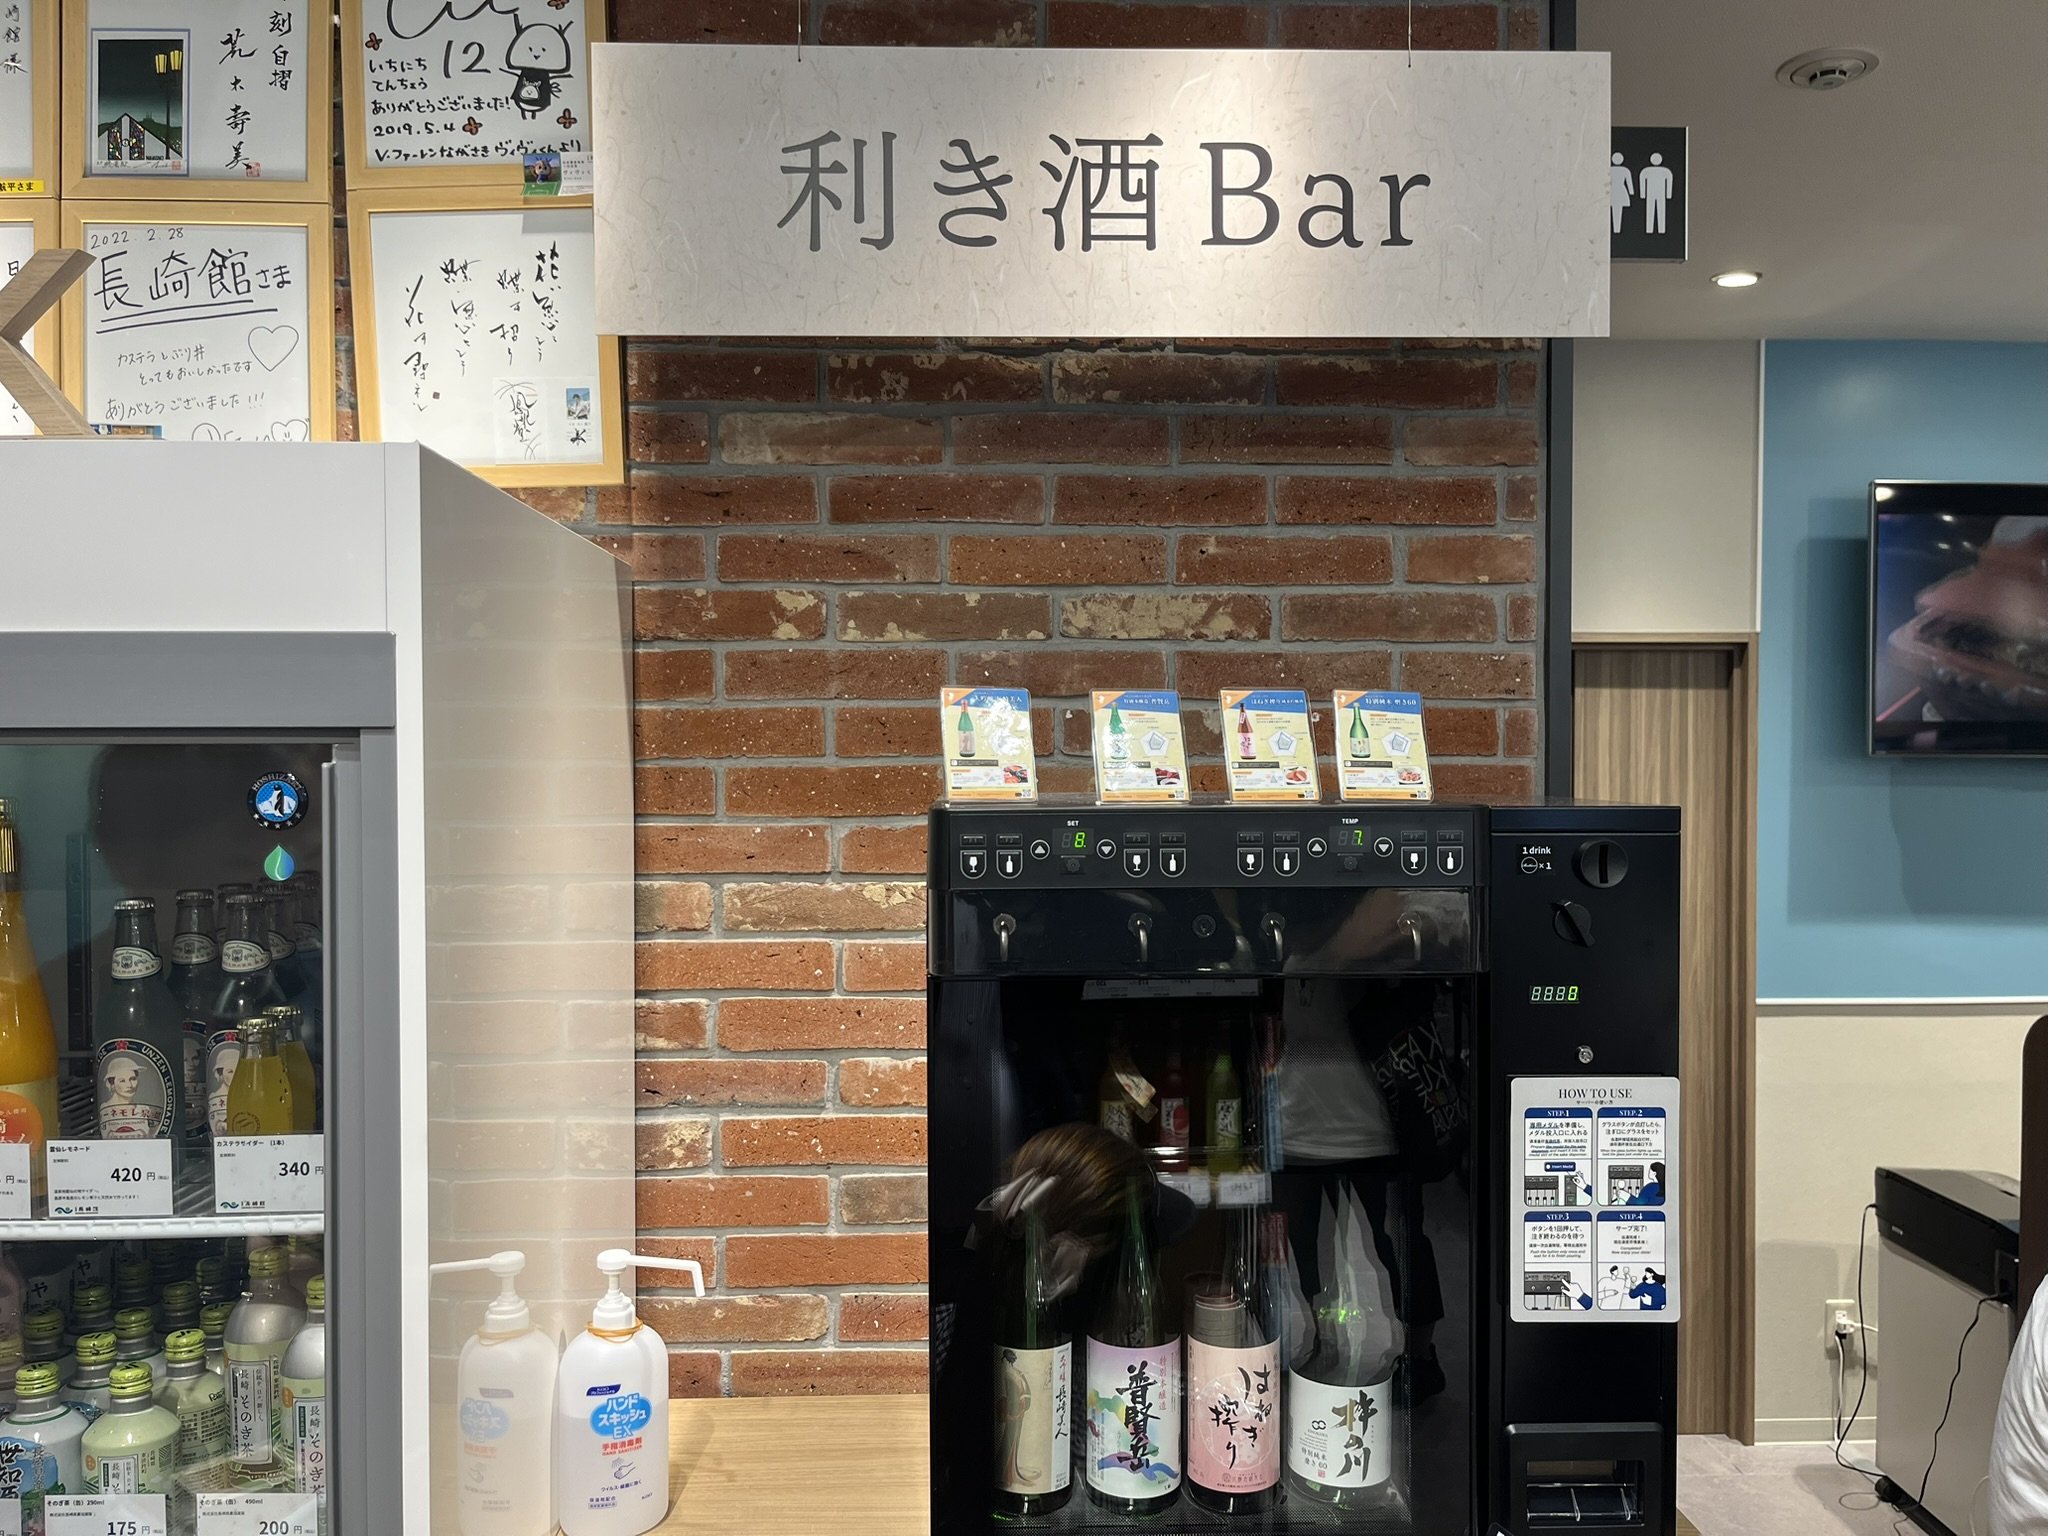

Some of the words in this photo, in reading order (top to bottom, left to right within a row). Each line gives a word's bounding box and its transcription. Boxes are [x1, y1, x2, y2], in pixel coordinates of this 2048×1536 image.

[369, 57, 428, 74] いちにち
[444, 40, 492, 79] 12
[371, 77, 428, 92] てんちょう
[371, 95, 512, 116] ありがとうございました!
[373, 122, 456, 137] 2019.5.4
[776, 129, 1165, 253] 利き酒
[1200, 141, 1432, 250] Bar
[94, 248, 293, 312] 長崎館さま
[139, 360, 253, 386] とってもおいしかったです
[1529, 846, 1551, 854] drink
[141, 1045, 168, 1073] UNZEN
[160, 1075, 174, 1133] LEMONADE
[1558, 1089, 1587, 1099] HOW
[1589, 1089, 1607, 1099] TO
[1610, 1089, 1633, 1099] USE
[110, 1167, 142, 1182] 420
[146, 1171, 156, 1181] 円
[278, 1161, 311, 1177] 340
[314, 1165, 324, 1175] 円
[5, 1175, 15, 1184] 円
[606, 1393, 641, 1413] ハンド
[598, 1408, 647, 1427] スキッシュ
[1115, 1360, 1161, 1472] 普賢岳
[613, 1424, 634, 1439] EX
[107, 1521, 137, 1536] 175
[141, 1525, 151, 1535] 円
[259, 1520, 290, 1536] 200
[293, 1525, 303, 1535] 円
